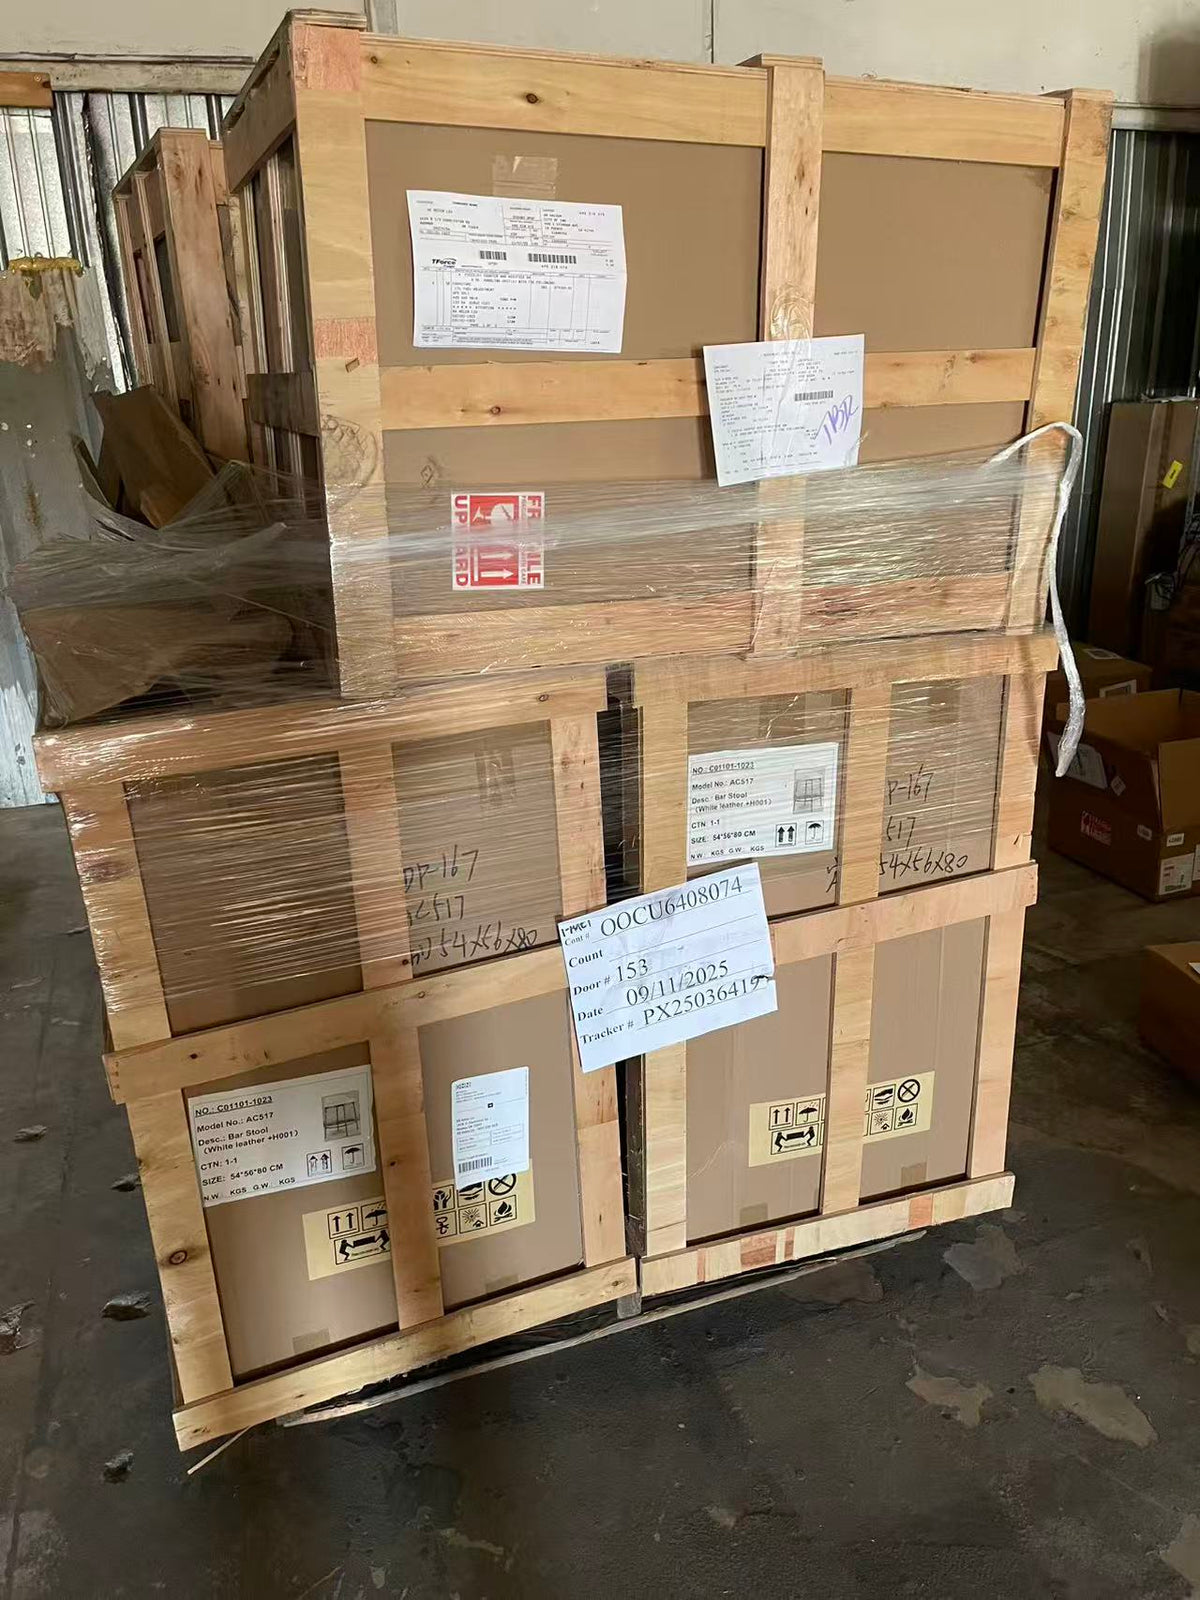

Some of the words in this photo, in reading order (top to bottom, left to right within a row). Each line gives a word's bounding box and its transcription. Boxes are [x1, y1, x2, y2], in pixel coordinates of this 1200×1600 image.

[431, 258, 457, 266] TForce
[527, 495, 541, 585] FRILE
[709, 762, 755, 773] C01101-1023
[692, 782, 713, 790] Model
[730, 778, 754, 786] AC517
[715, 793, 726, 801] Bar
[728, 792, 748, 800] Stool
[720, 801, 744, 809] leather
[600, 876, 743, 937] OOCU6408074
[564, 935, 584, 946] Cont
[568, 949, 603, 968] Count
[573, 979, 601, 996] Door
[604, 976, 610, 985] #
[617, 958, 649, 982] 153
[577, 1007, 604, 1022] Date
[626, 960, 729, 1007] 09/11/2025
[580, 1022, 625, 1046] Tracker
[626, 1020, 634, 1029] #
[217, 1096, 273, 1113] C01101-1023
[197, 1120, 223, 1132] Model
[226, 1118, 243, 1127] No.:
[246, 1112, 274, 1123] AC517
[198, 1136, 226, 1146] Desc.:
[228, 1132, 243, 1141] Bar
[246, 1127, 268, 1137] Stool
[235, 1137, 265, 1148] leather
[200, 1161, 222, 1171] CTN:
[225, 1157, 238, 1165] 1-1
[202, 1175, 226, 1186] SIZE:
[269, 1163, 284, 1172] CM
[230, 1187, 247, 1195] KGS
[279, 1177, 296, 1185] KGS
